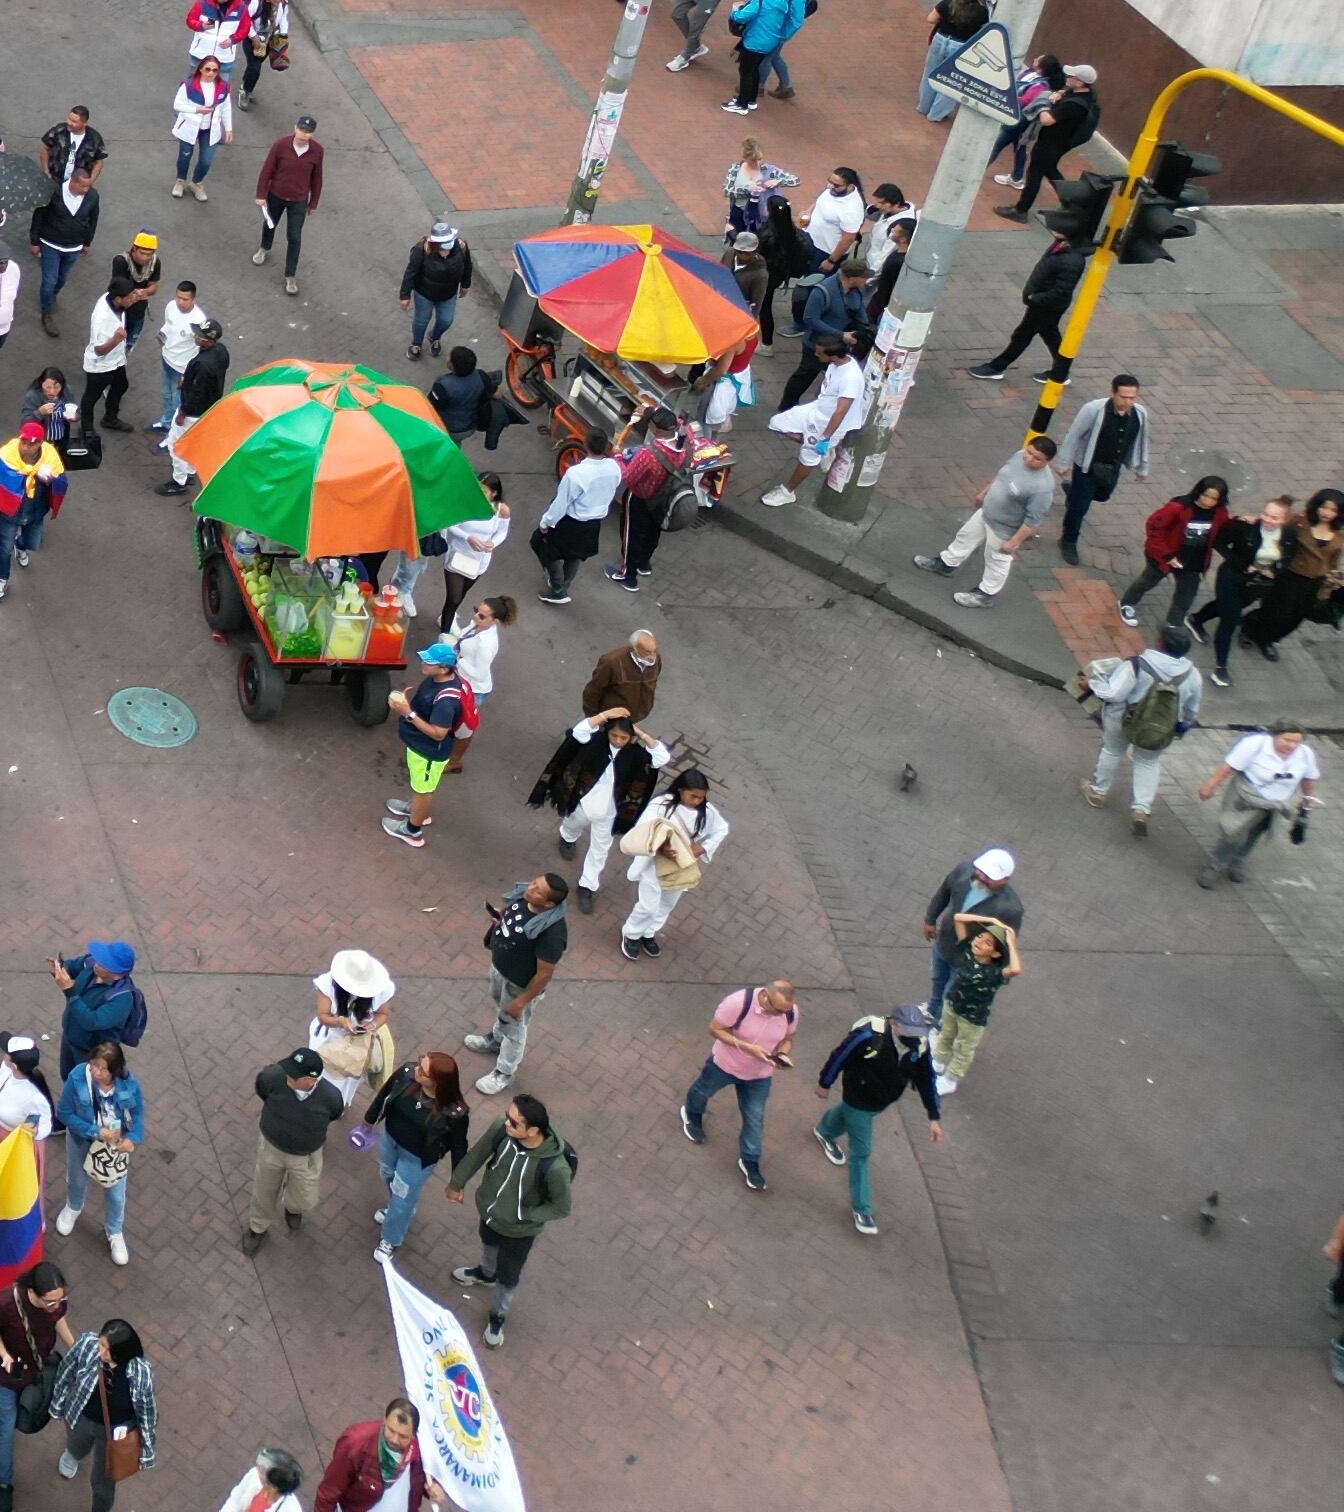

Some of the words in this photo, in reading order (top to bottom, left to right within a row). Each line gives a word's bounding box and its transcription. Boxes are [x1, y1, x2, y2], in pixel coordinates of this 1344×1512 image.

[936, 73, 963, 91] SIENDO
[963, 87, 1015, 115] MONITOREADA
[950, 71, 968, 84] ESTA
[968, 81, 989, 94] ZONA
